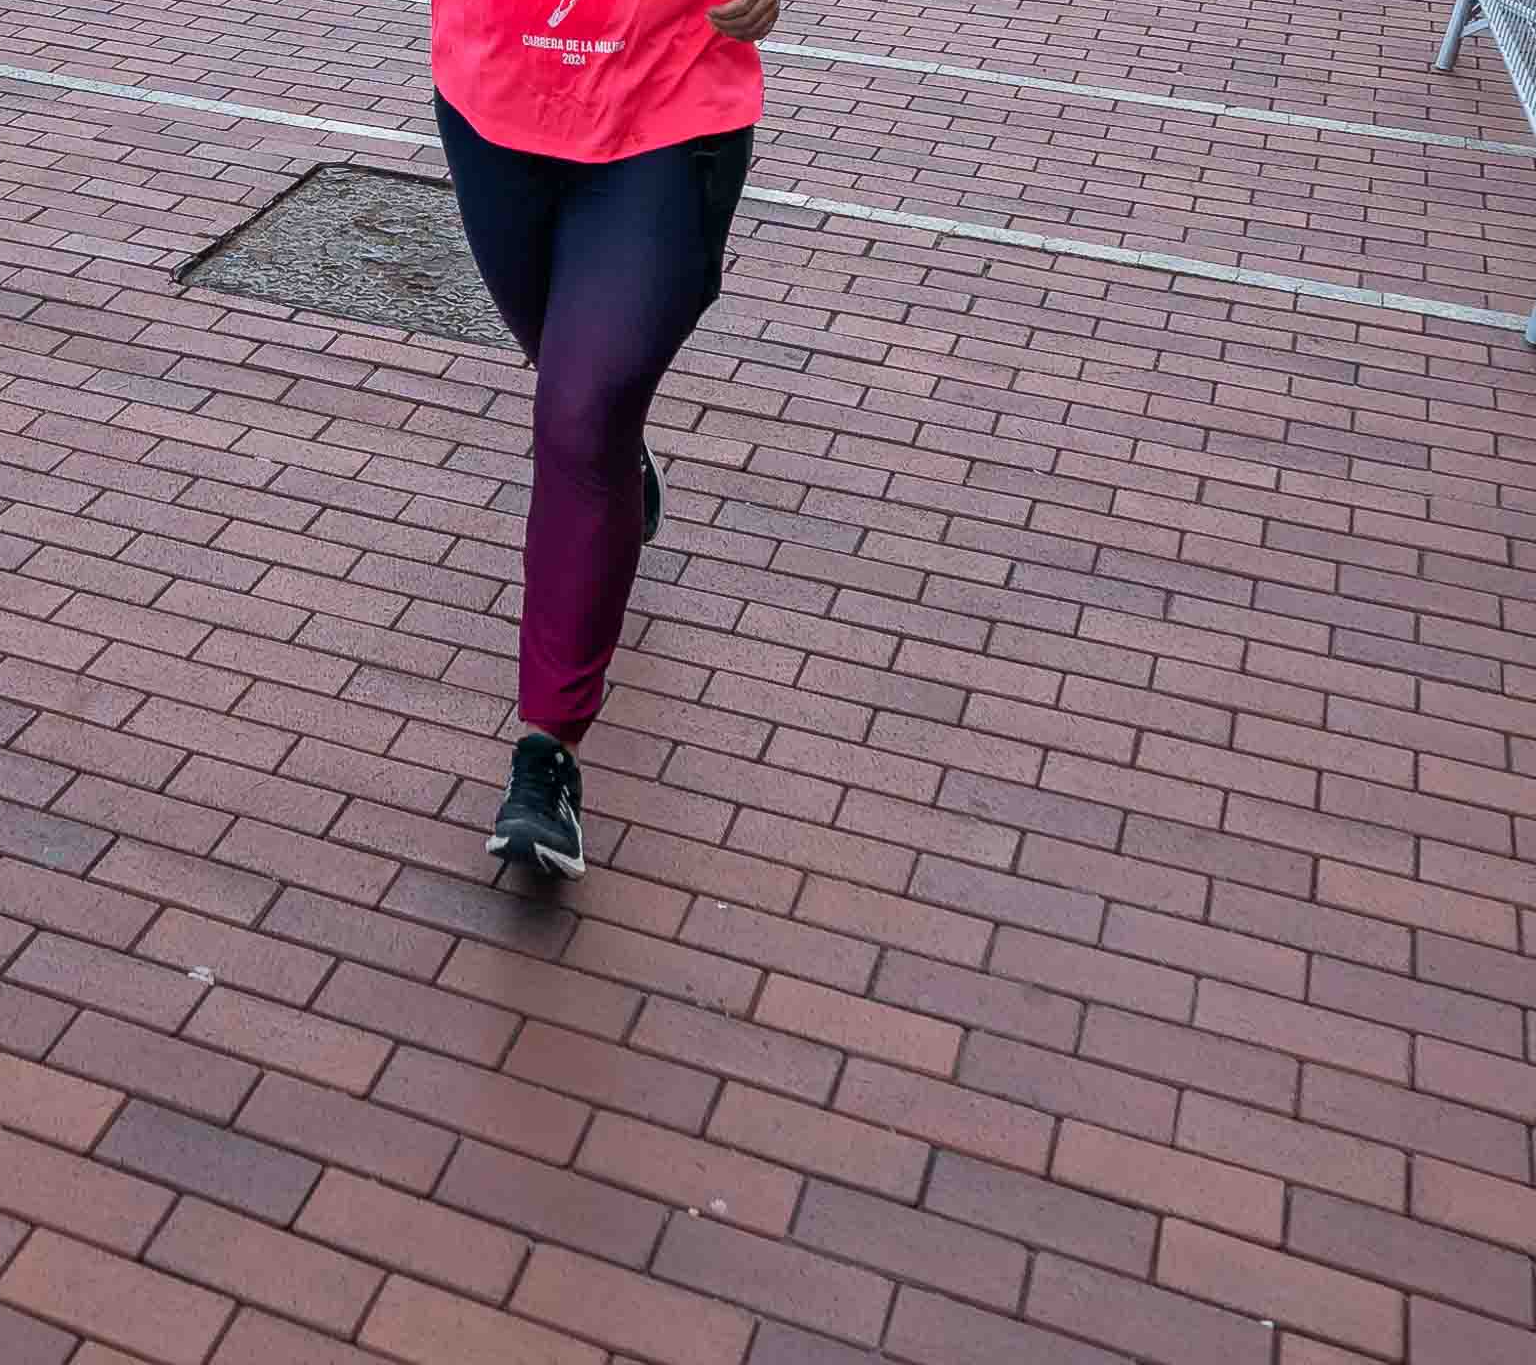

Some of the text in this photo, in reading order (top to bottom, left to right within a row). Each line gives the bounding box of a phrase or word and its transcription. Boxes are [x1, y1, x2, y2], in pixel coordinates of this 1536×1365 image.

[522, 34, 563, 50] CARRERA
[566, 39, 580, 52] DE
[581, 40, 593, 53] LA
[561, 52, 586, 65] 2024
